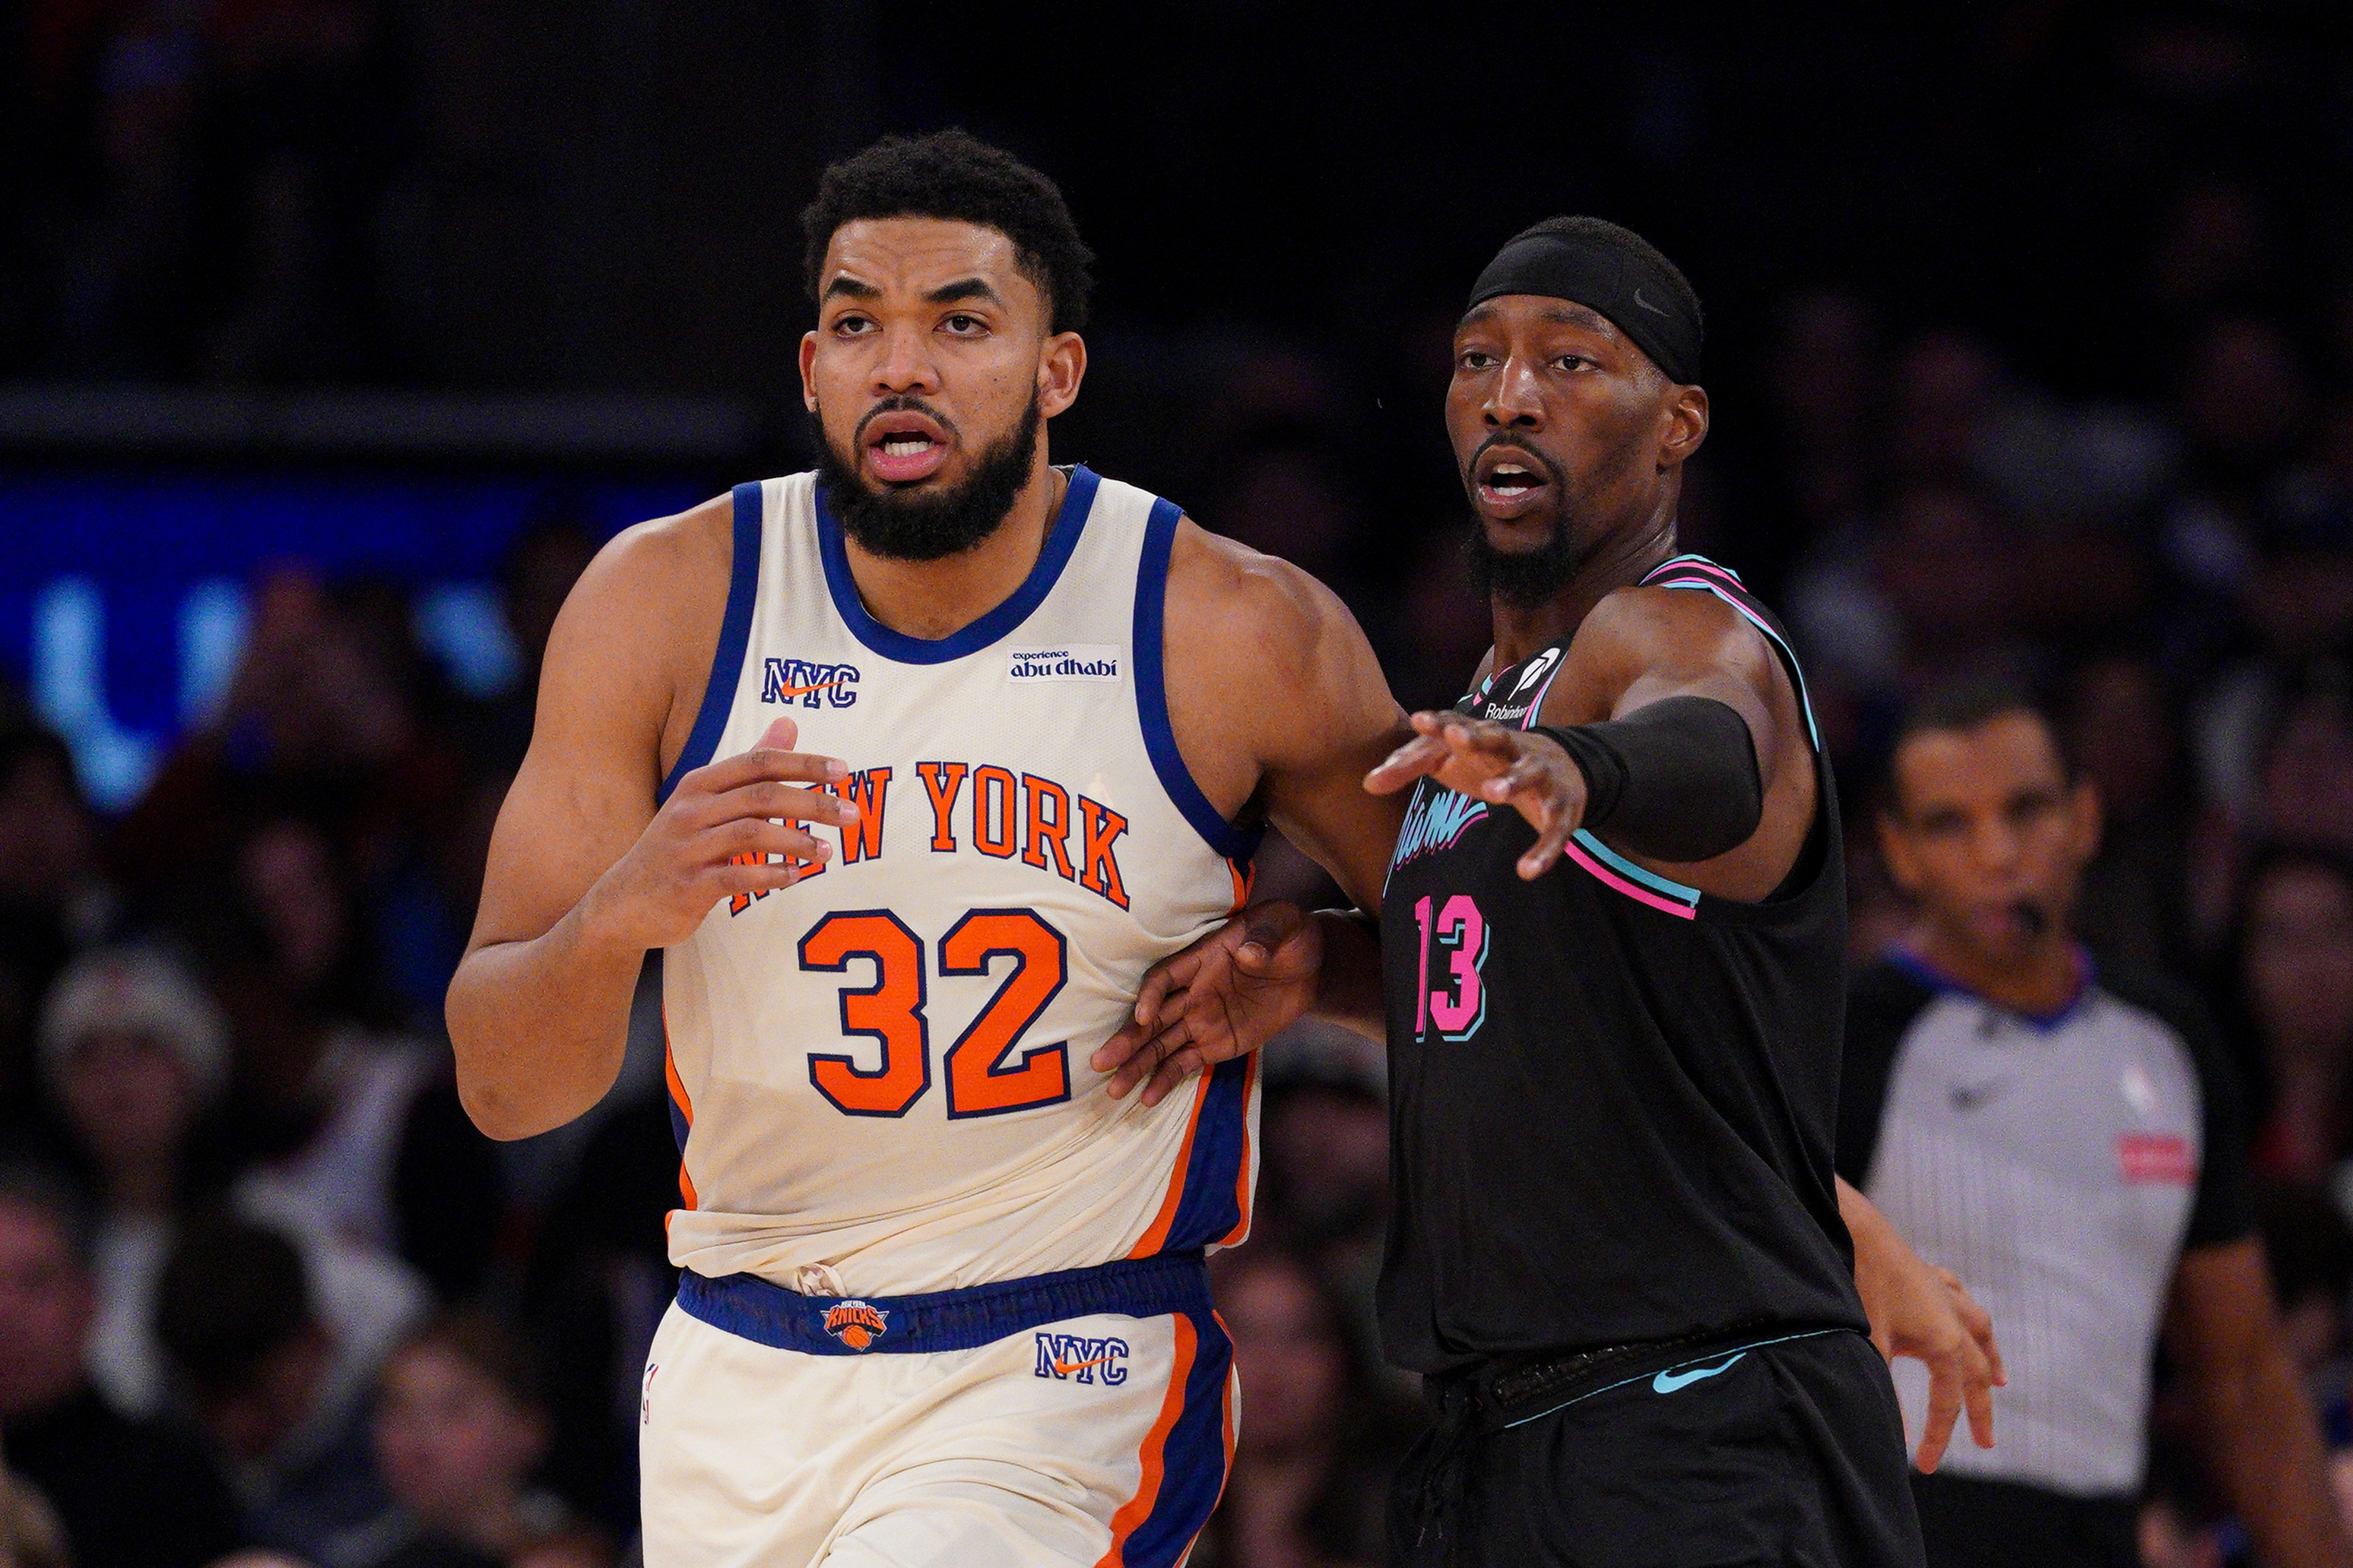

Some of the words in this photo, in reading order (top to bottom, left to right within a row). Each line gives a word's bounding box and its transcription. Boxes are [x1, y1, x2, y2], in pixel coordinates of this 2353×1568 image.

[1011, 662, 1051, 677] abu
[1055, 659, 1117, 676] dhabi
[1013, 651, 1069, 660] experience
[761, 658, 861, 709] NYC
[915, 761, 1131, 913] YORK
[1415, 895, 1490, 1044] 13
[798, 908, 1071, 1120] 32
[825, 1307, 885, 1330] KNICKS
[1035, 1332, 1129, 1386] NYC
